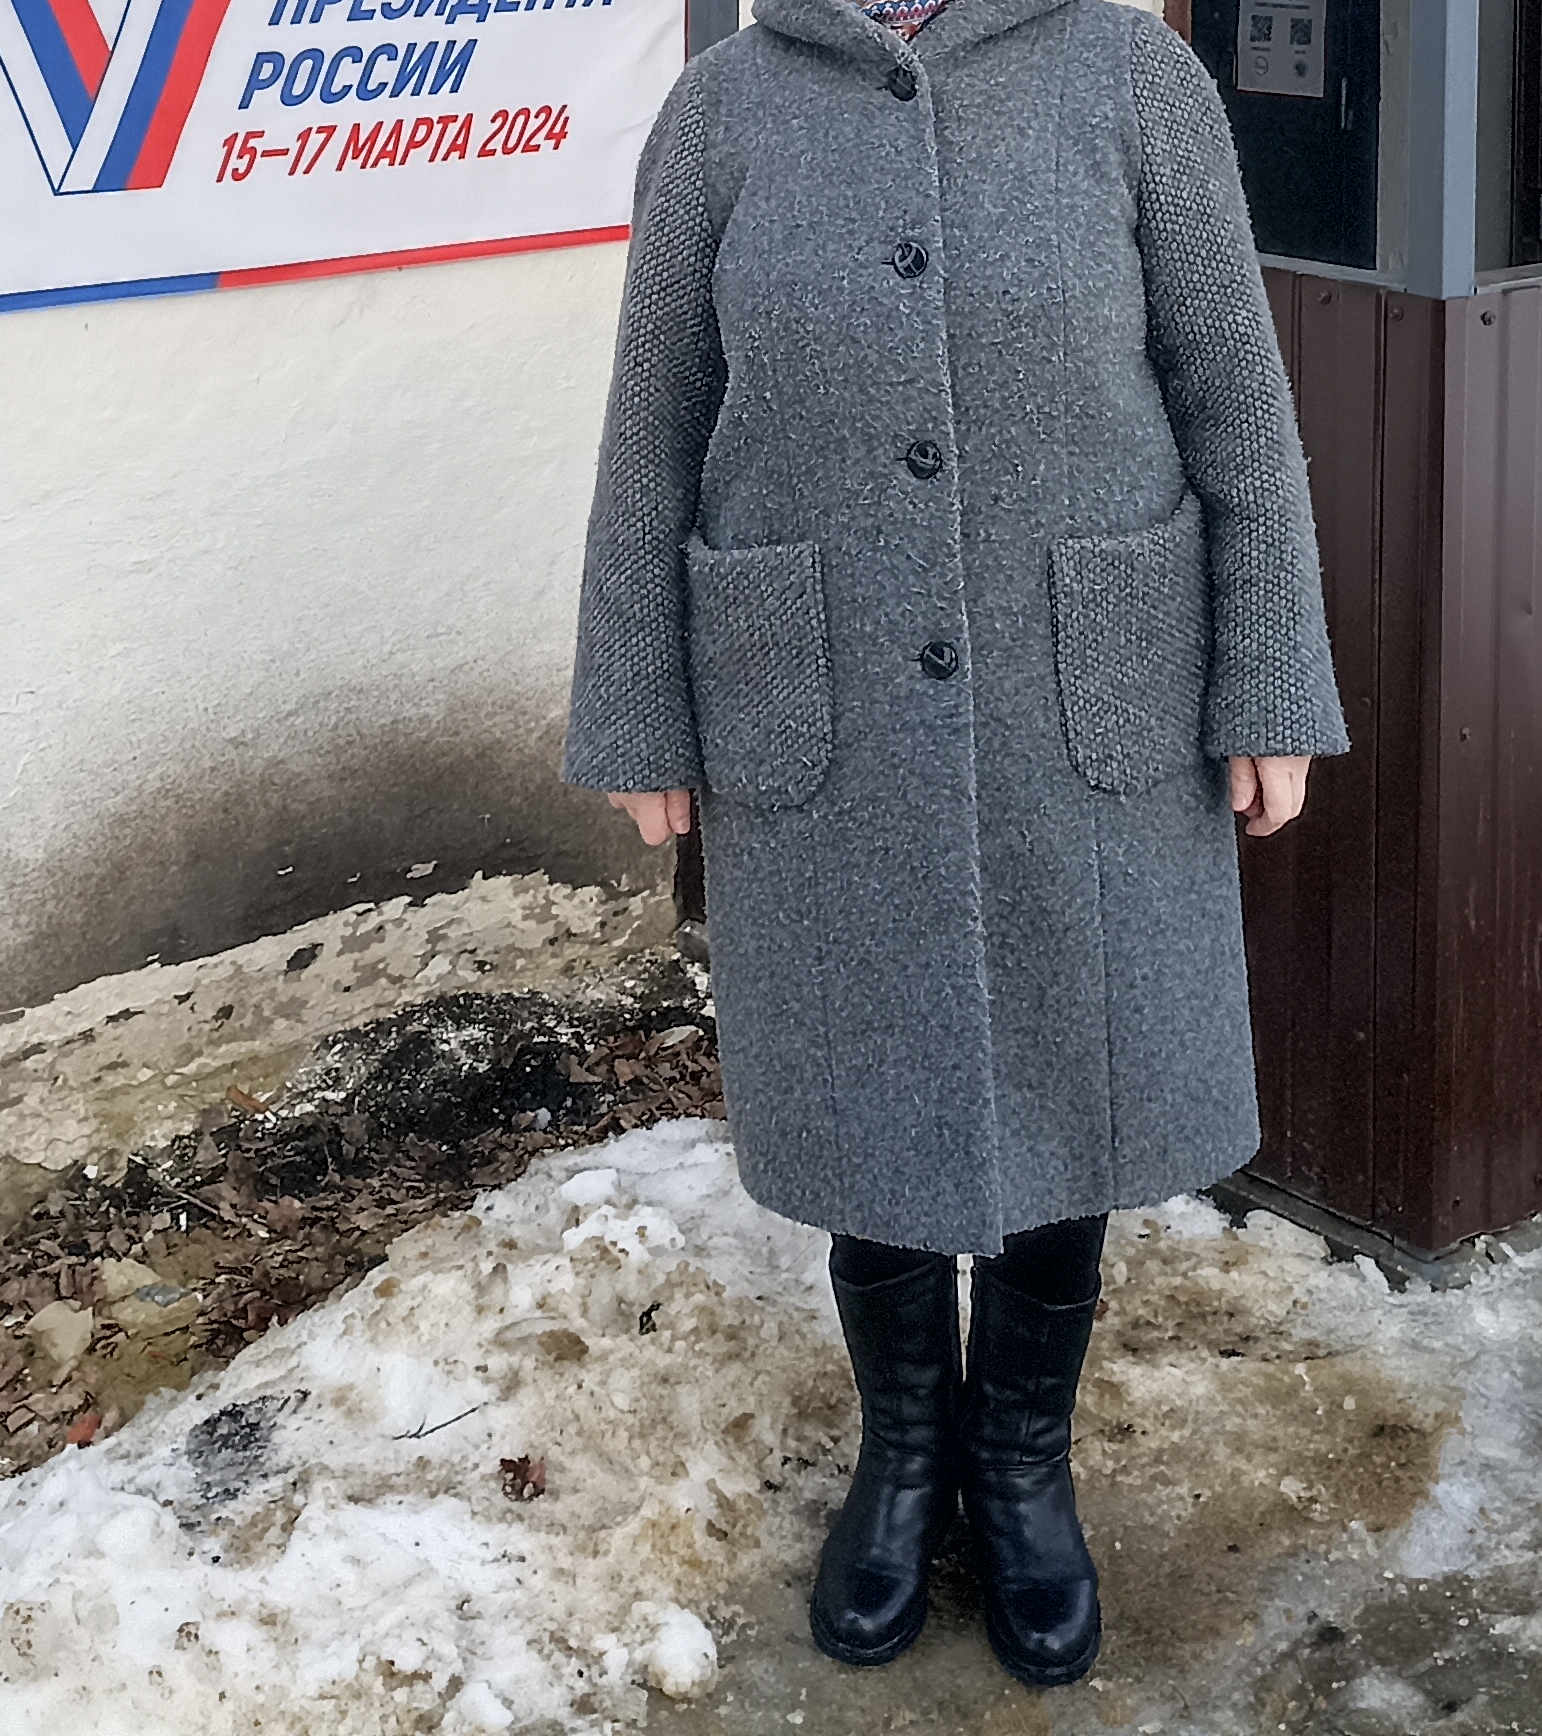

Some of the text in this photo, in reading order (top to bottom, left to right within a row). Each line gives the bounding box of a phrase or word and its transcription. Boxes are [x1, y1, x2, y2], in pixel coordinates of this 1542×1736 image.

[238, 39, 479, 111] РОССИИ
[337, 115, 473, 173] МАРТА
[476, 105, 571, 159] 2024
